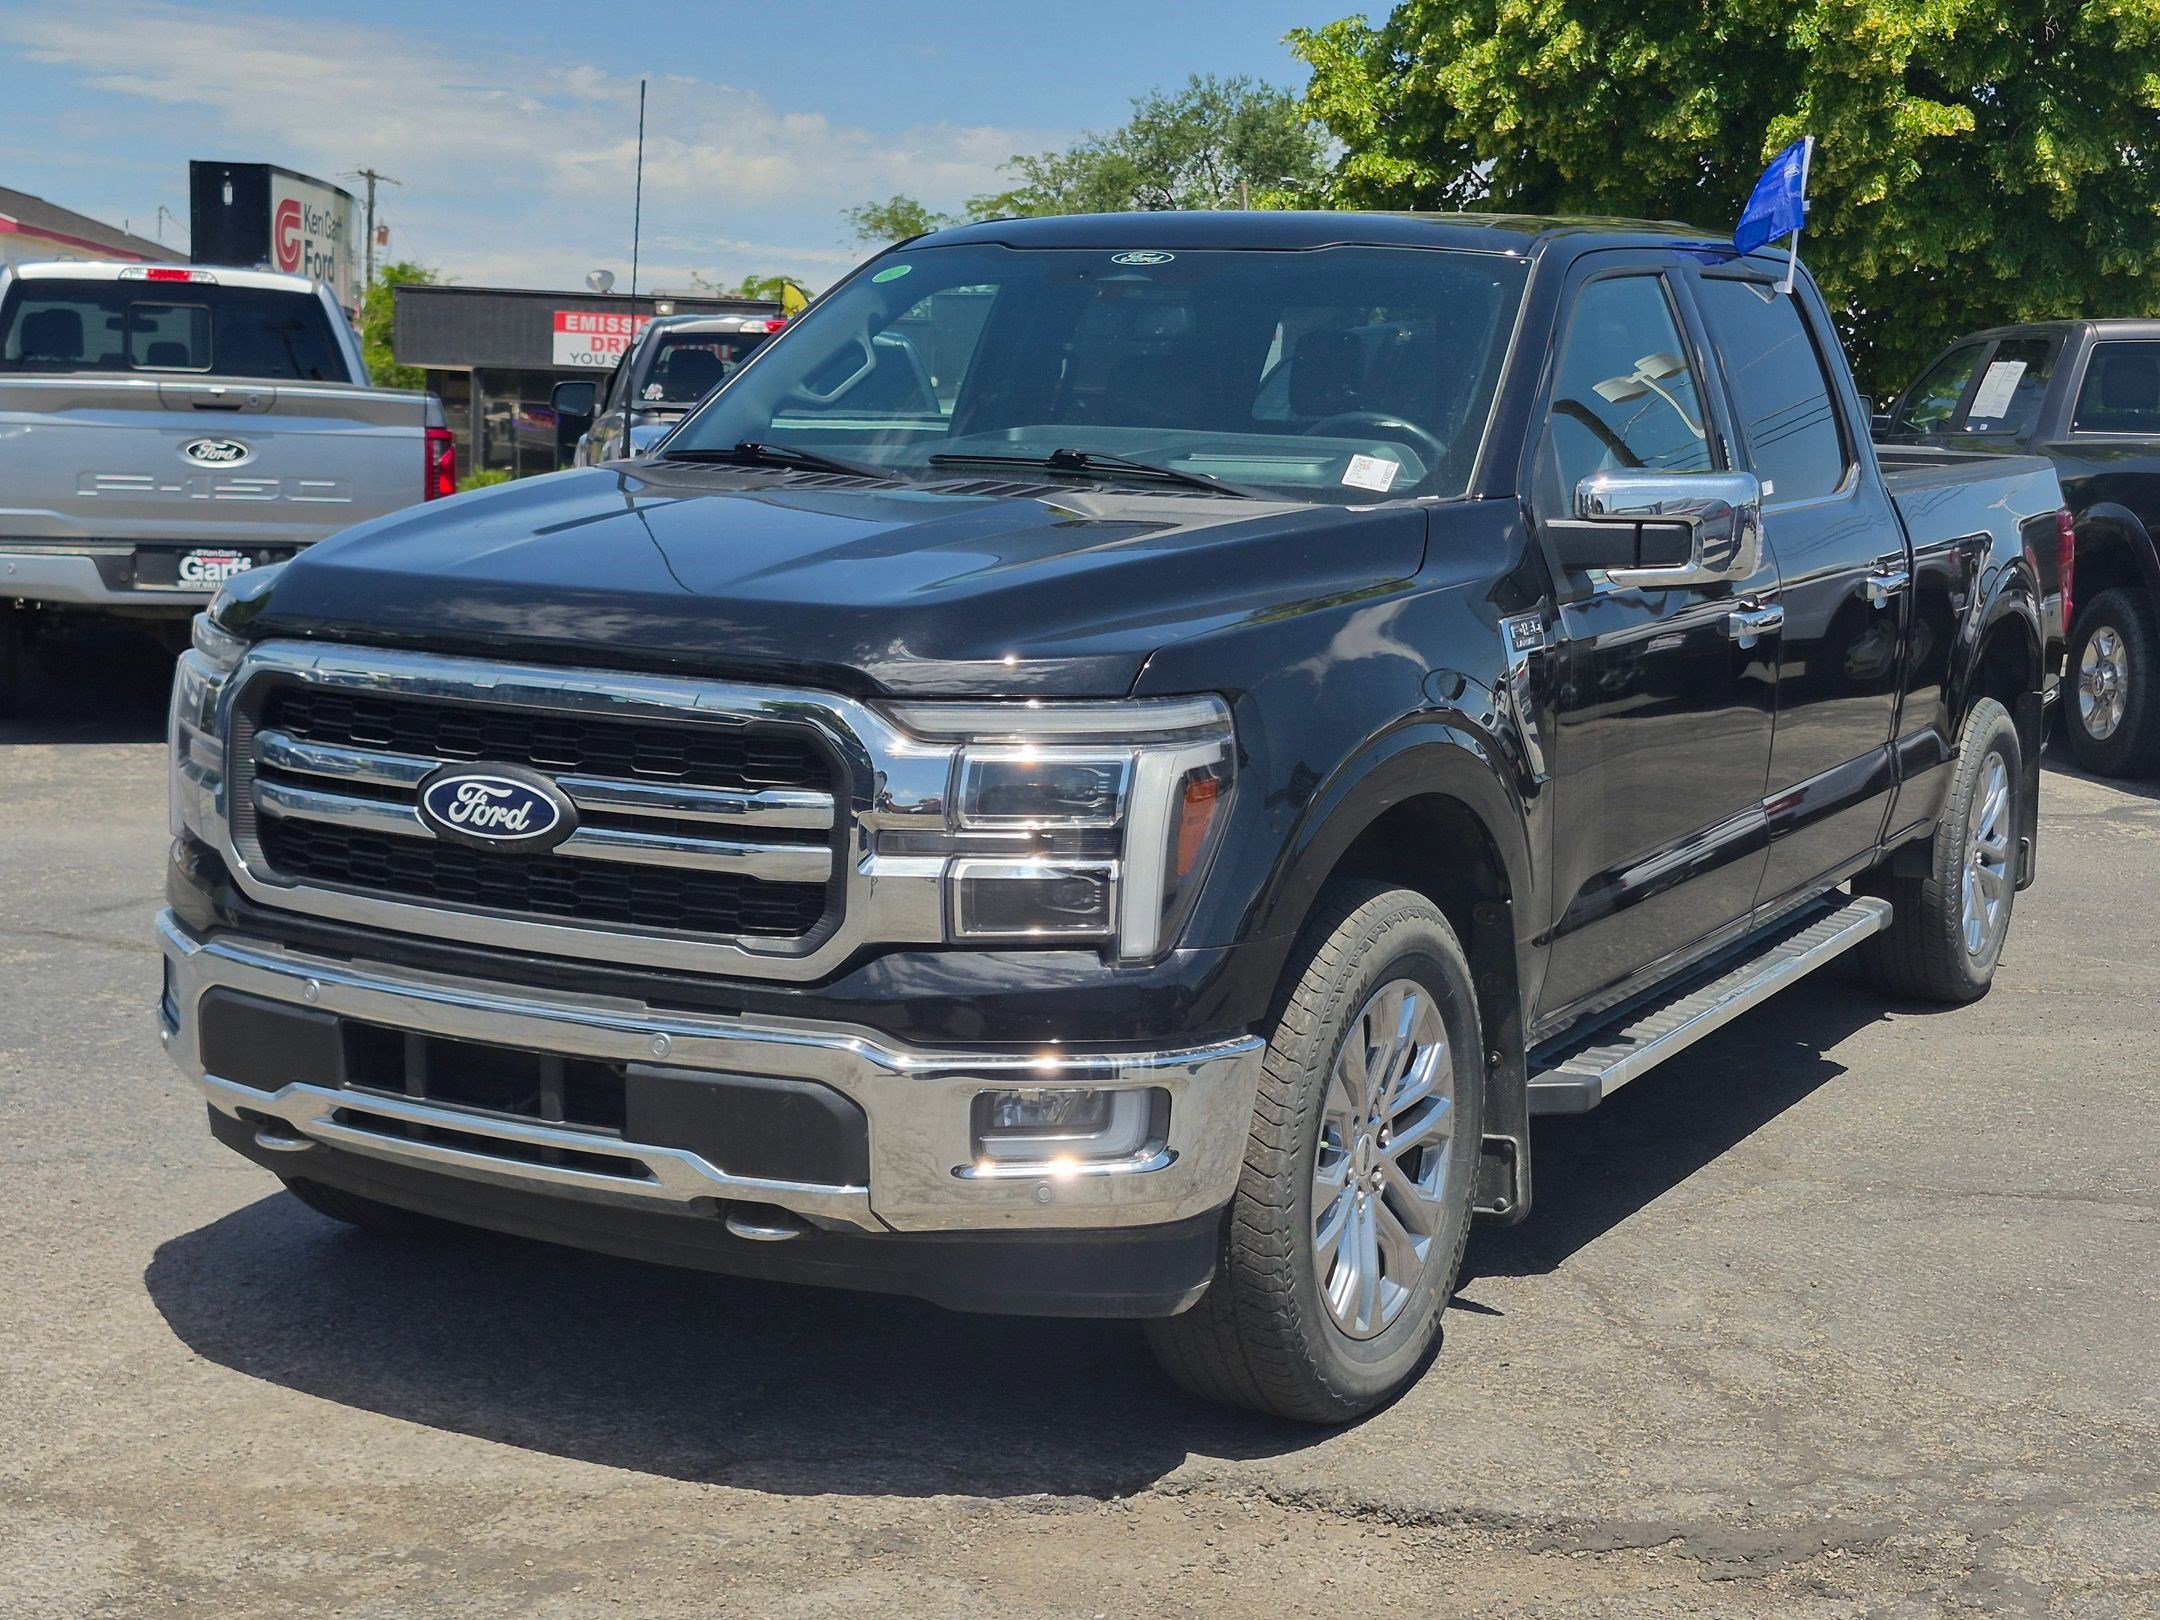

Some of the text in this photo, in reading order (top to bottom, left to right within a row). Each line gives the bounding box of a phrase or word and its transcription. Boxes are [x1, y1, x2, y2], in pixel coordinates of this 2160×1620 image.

[304, 204, 324, 236] Ken
[304, 239, 335, 283] Ford
[564, 314, 649, 334] EMISSI
[570, 353, 606, 365] YOU
[196, 442, 238, 460] Ford
[77, 471, 352, 503] F-150
[448, 782, 533, 831] Ford
